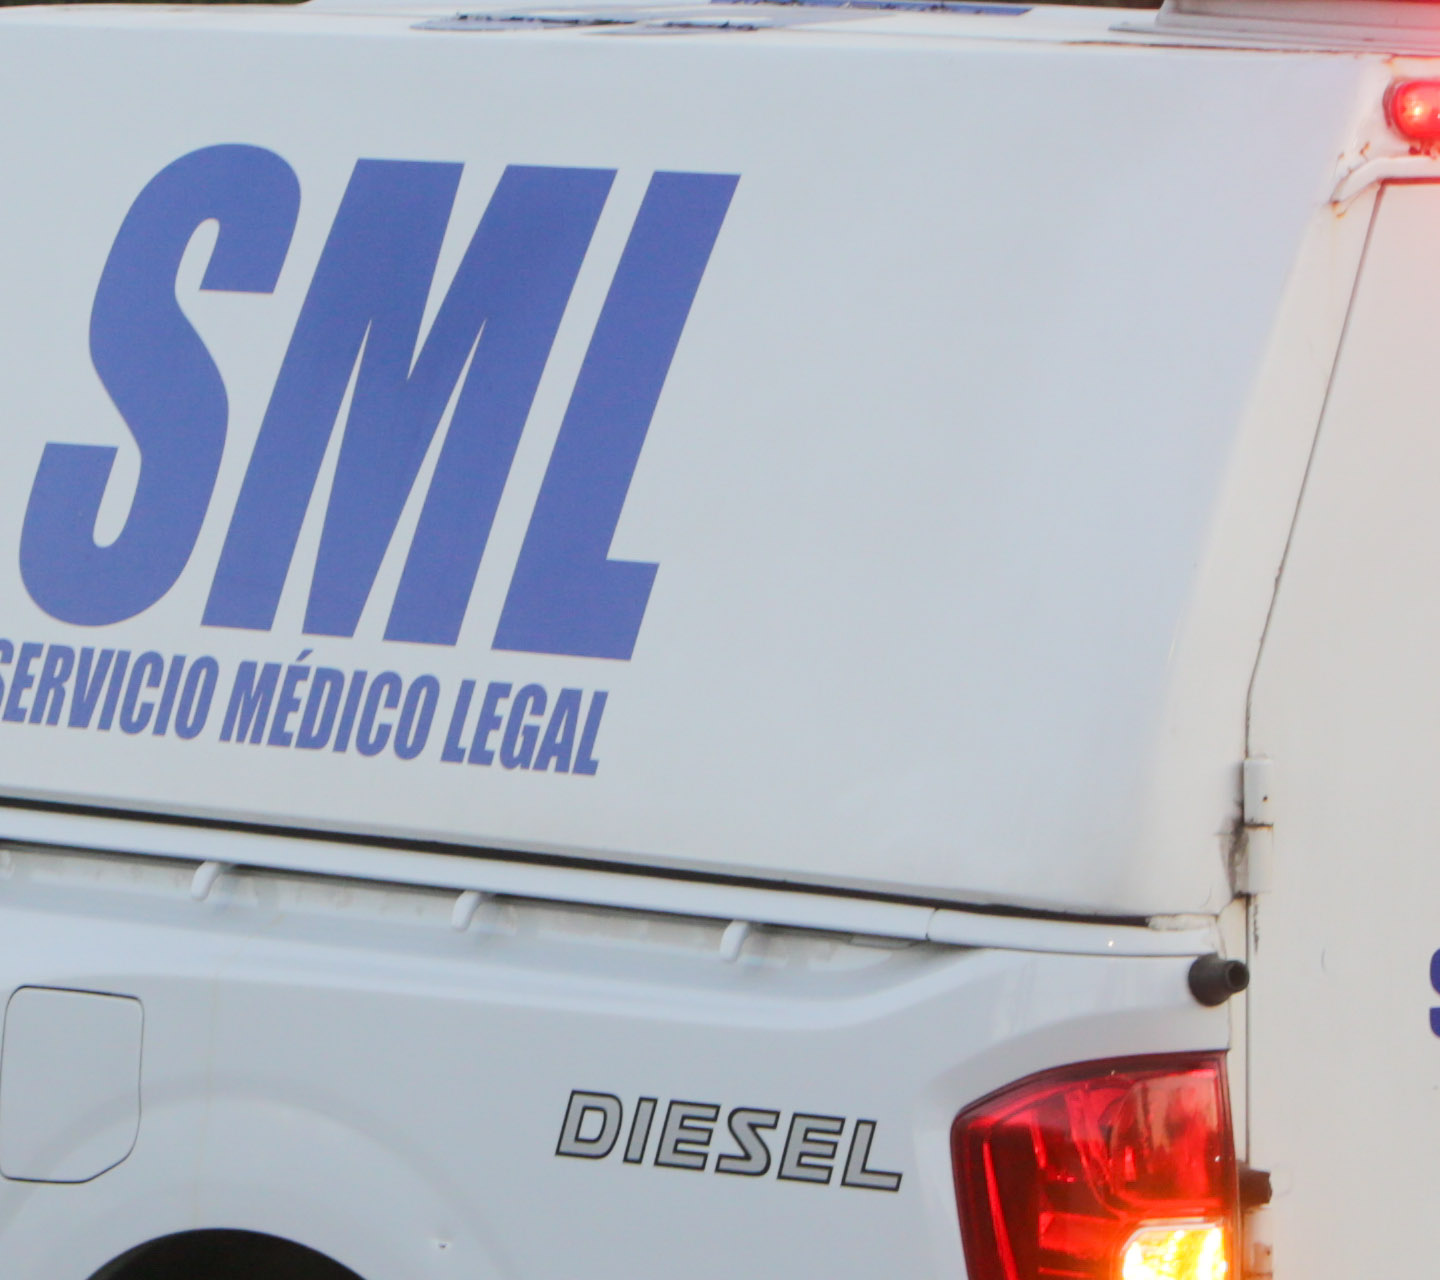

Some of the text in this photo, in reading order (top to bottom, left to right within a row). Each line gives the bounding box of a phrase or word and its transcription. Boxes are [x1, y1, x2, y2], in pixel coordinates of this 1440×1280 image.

[19, 144, 740, 660] SML
[219, 649, 438, 760] MÉDICO
[441, 678, 609, 776] LEGAL
[555, 1089, 903, 1193] DIESEL
